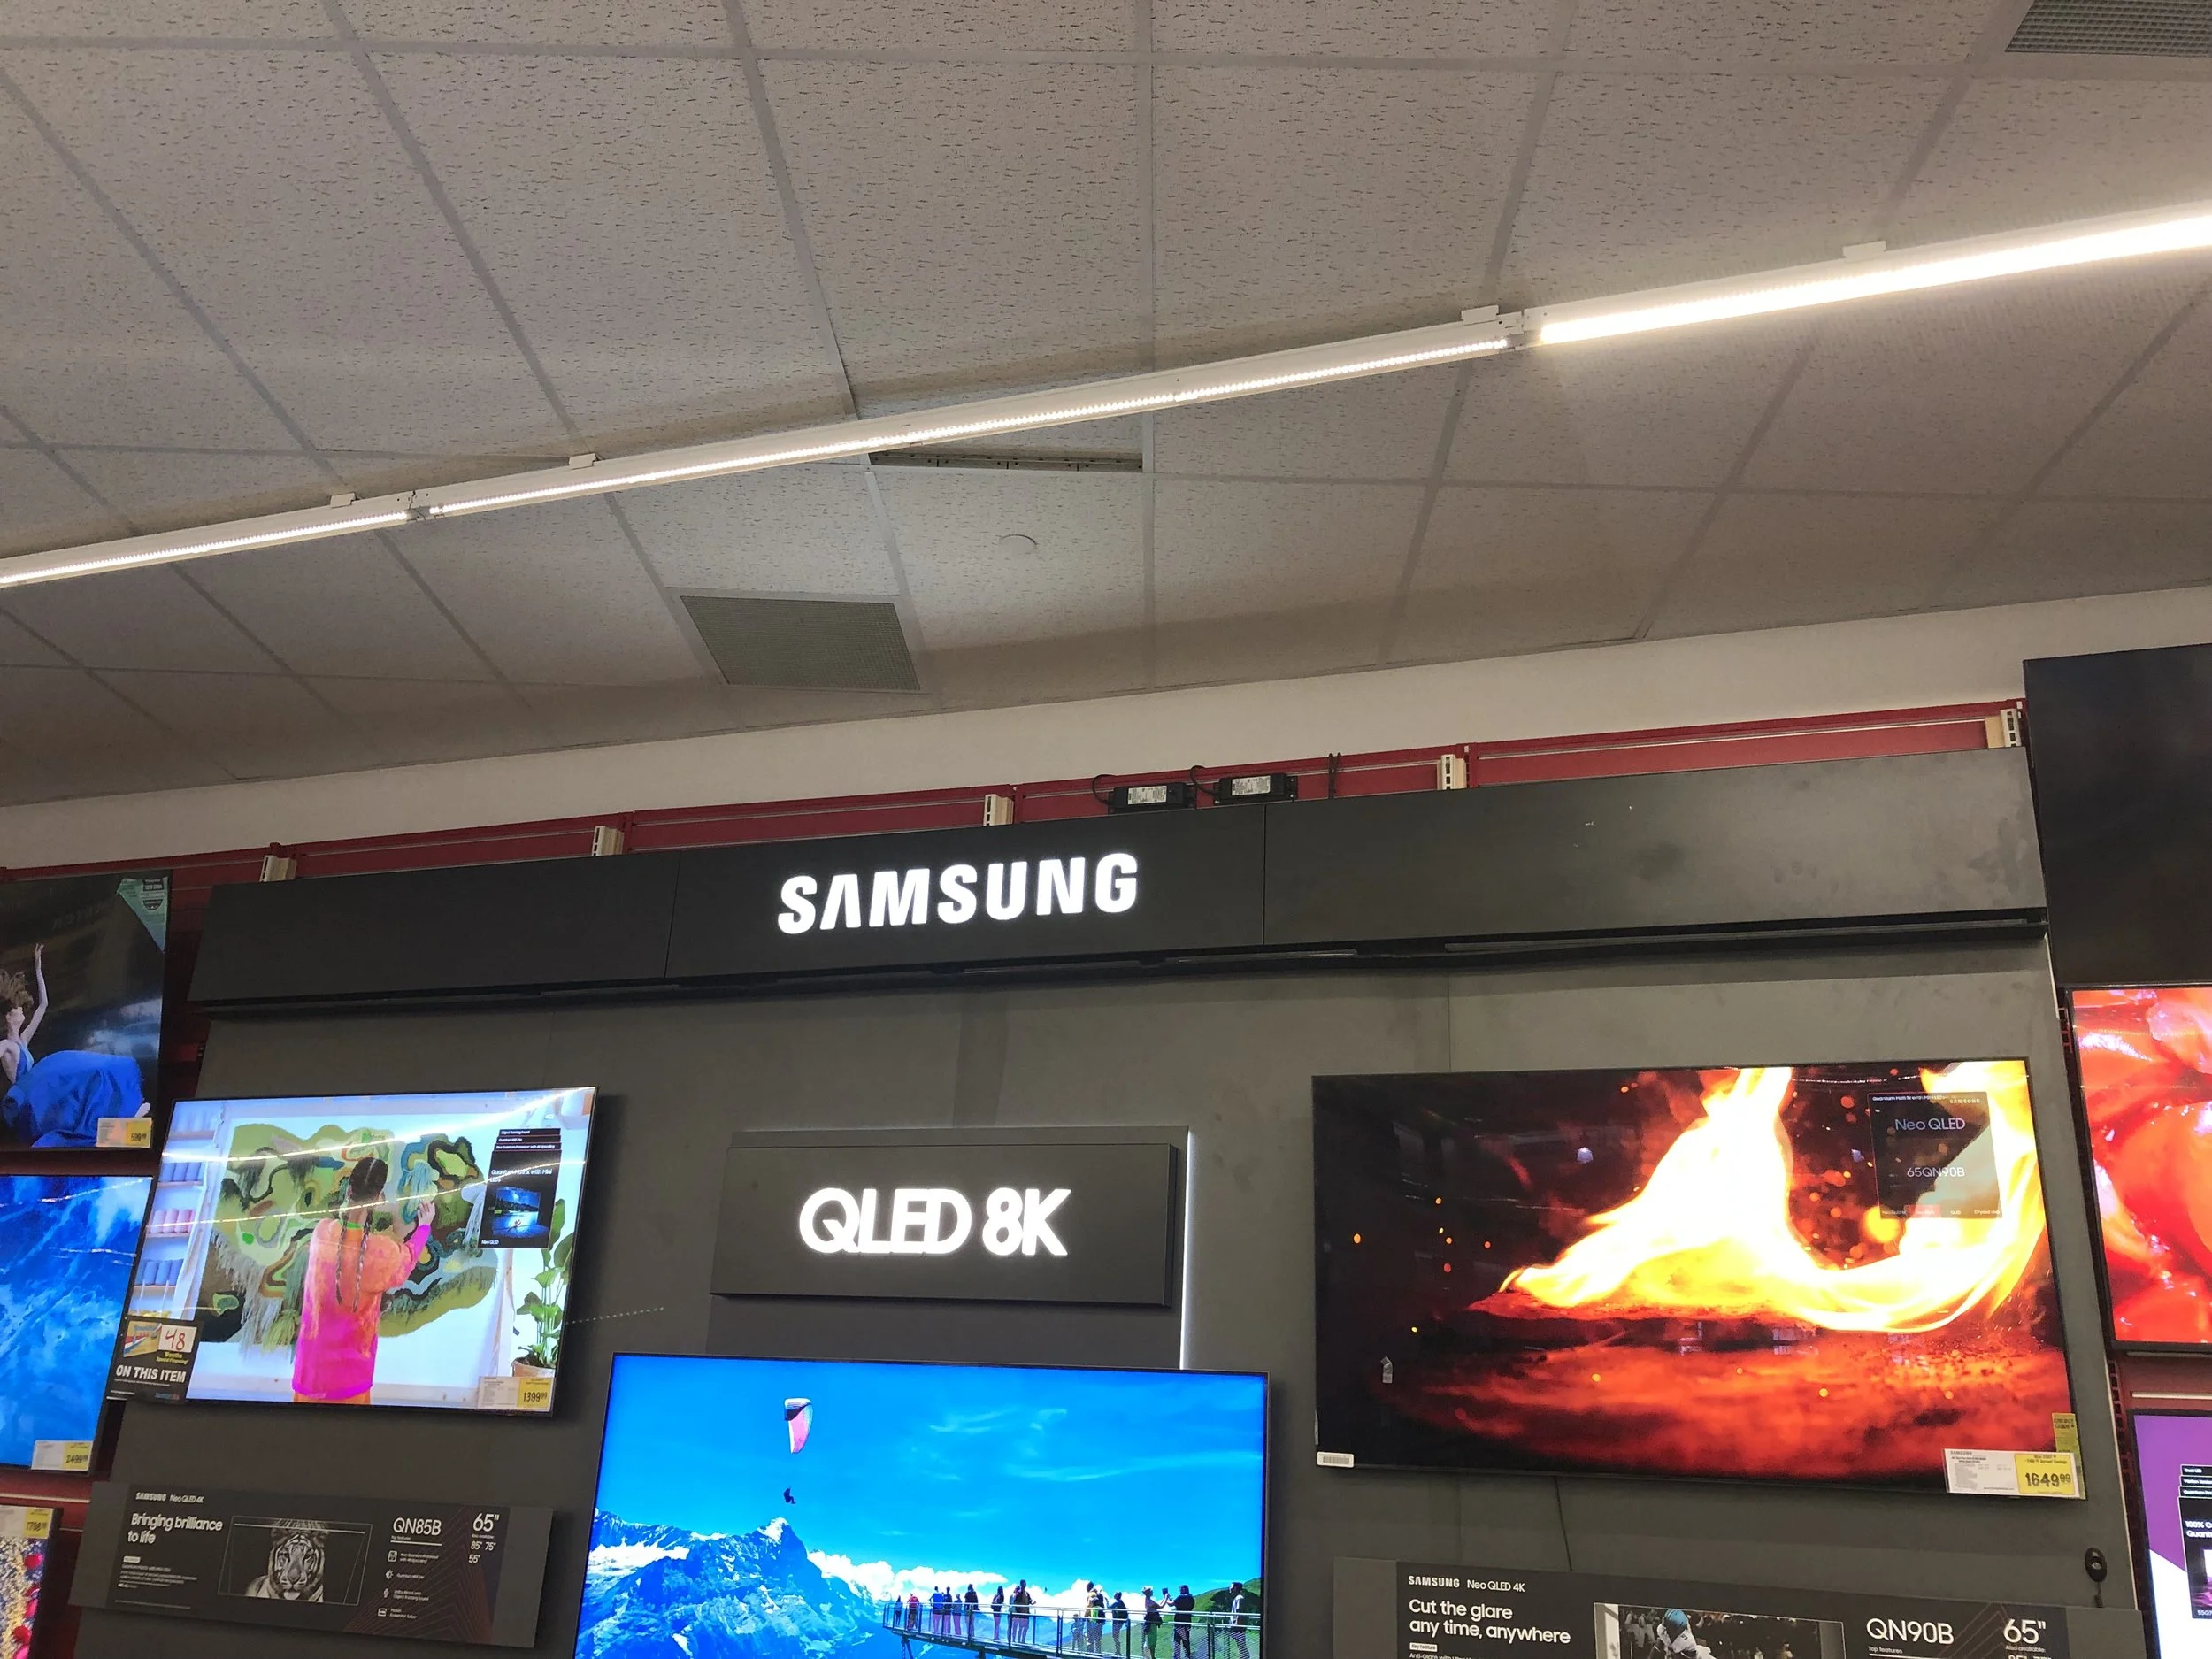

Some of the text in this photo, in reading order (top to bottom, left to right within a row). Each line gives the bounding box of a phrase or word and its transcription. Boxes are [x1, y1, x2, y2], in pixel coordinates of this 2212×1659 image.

[778, 853, 1138, 934] SAMSUNG
[1894, 1118, 1966, 1131] Neo QLED
[1907, 1167, 1965, 1178] 65QN90B
[799, 1187, 1072, 1257] QLED 8K
[165, 1328, 186, 1351] 48
[116, 1364, 132, 1378] ON
[134, 1366, 159, 1380] THIS
[159, 1369, 187, 1383] ITEM
[2024, 1472, 2060, 1487] 1649
[135, 1492, 167, 1502] SAMSUNG
[131, 1512, 223, 1532] Bringing brilliance
[393, 1517, 442, 1536] QN85B
[127, 1530, 156, 1544] to life
[1408, 1575, 1525, 1592] SAMSUNG Neo QLED 4K
[1409, 1599, 1513, 1622] Cut the glare
[1409, 1619, 1571, 1644] any time, anywhere
[1866, 1617, 2047, 1645] QN90B 65"
